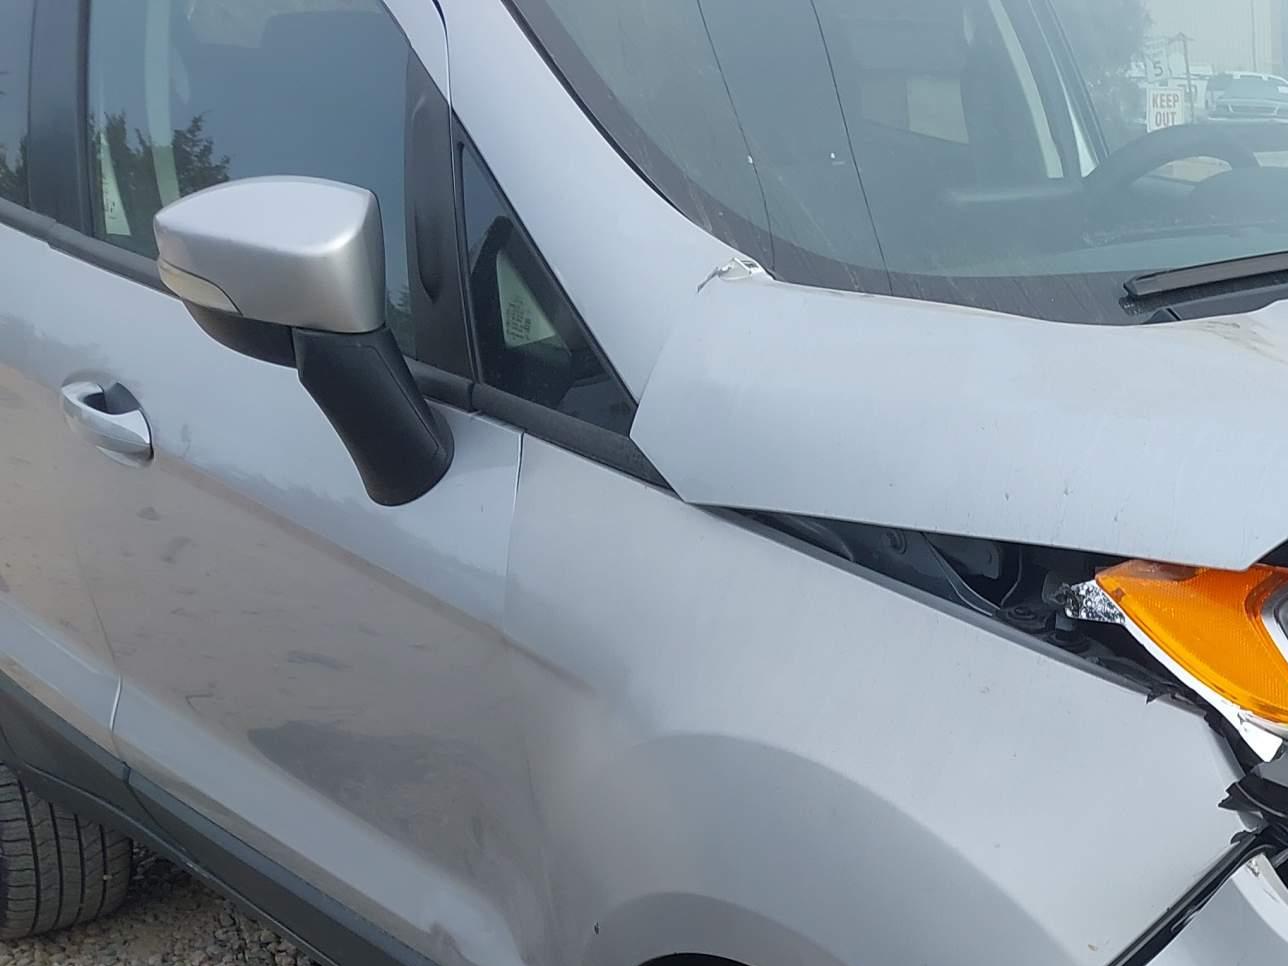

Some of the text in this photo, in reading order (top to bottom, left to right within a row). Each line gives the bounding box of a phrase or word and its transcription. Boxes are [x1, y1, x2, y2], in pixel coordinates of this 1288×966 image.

[1153, 61, 1164, 77] 5
[1152, 93, 1180, 109] KEEP
[1155, 111, 1177, 127] OUT
